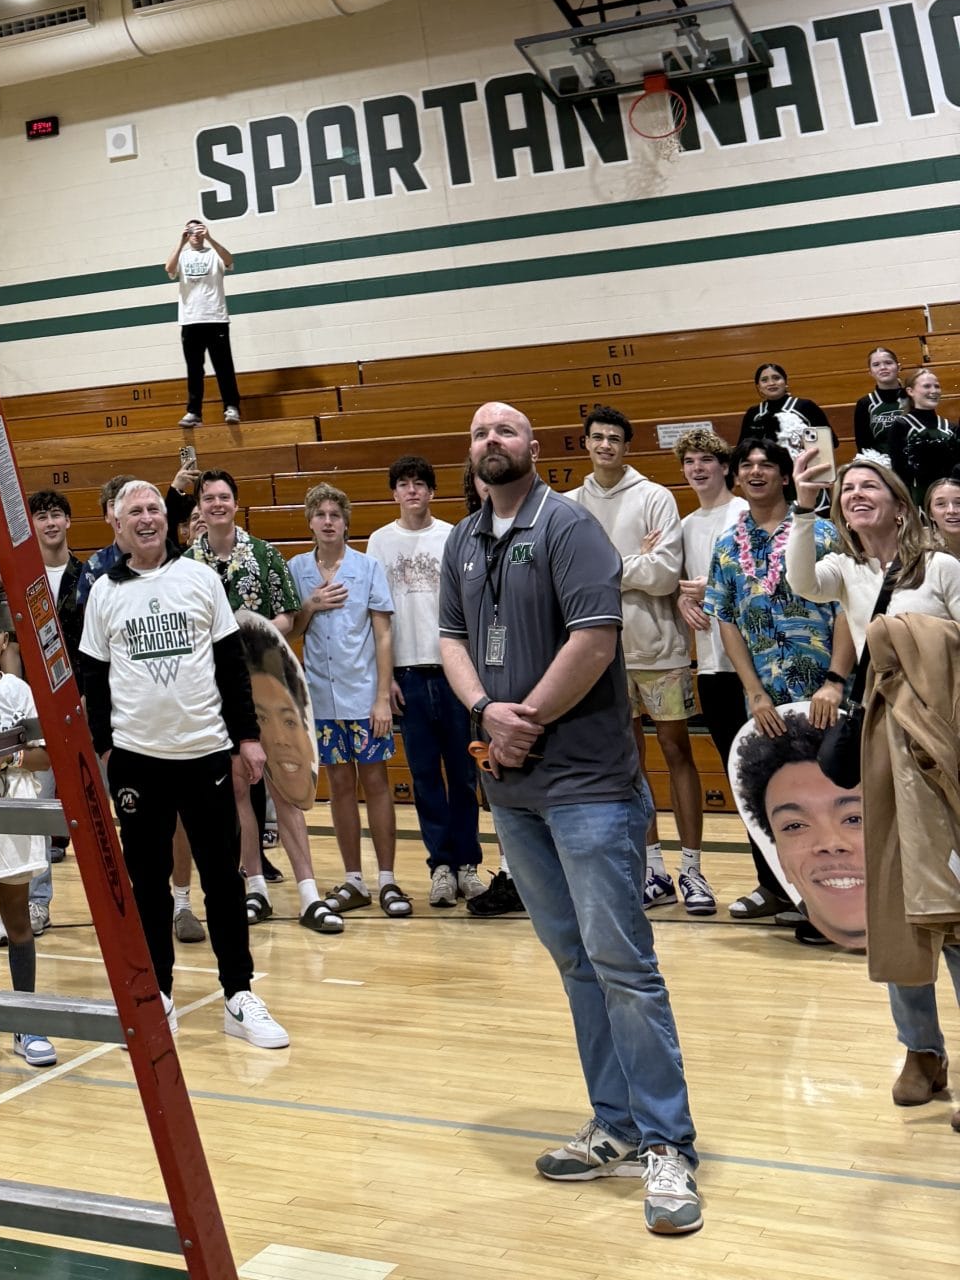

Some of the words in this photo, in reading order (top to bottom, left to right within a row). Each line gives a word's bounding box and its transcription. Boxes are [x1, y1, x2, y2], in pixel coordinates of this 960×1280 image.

[197, 66, 628, 220] SPARTAN
[608, 345, 617, 359] E
[592, 375, 601, 388] E
[548, 469, 558, 483] E
[563, 469, 573, 483] 7
[510, 542, 535, 564] M
[125, 611, 188, 637] MADISON
[128, 629, 192, 655] MEMORIAL
[86, 781, 120, 888] WERNER
[592, 1141, 620, 1164] N
